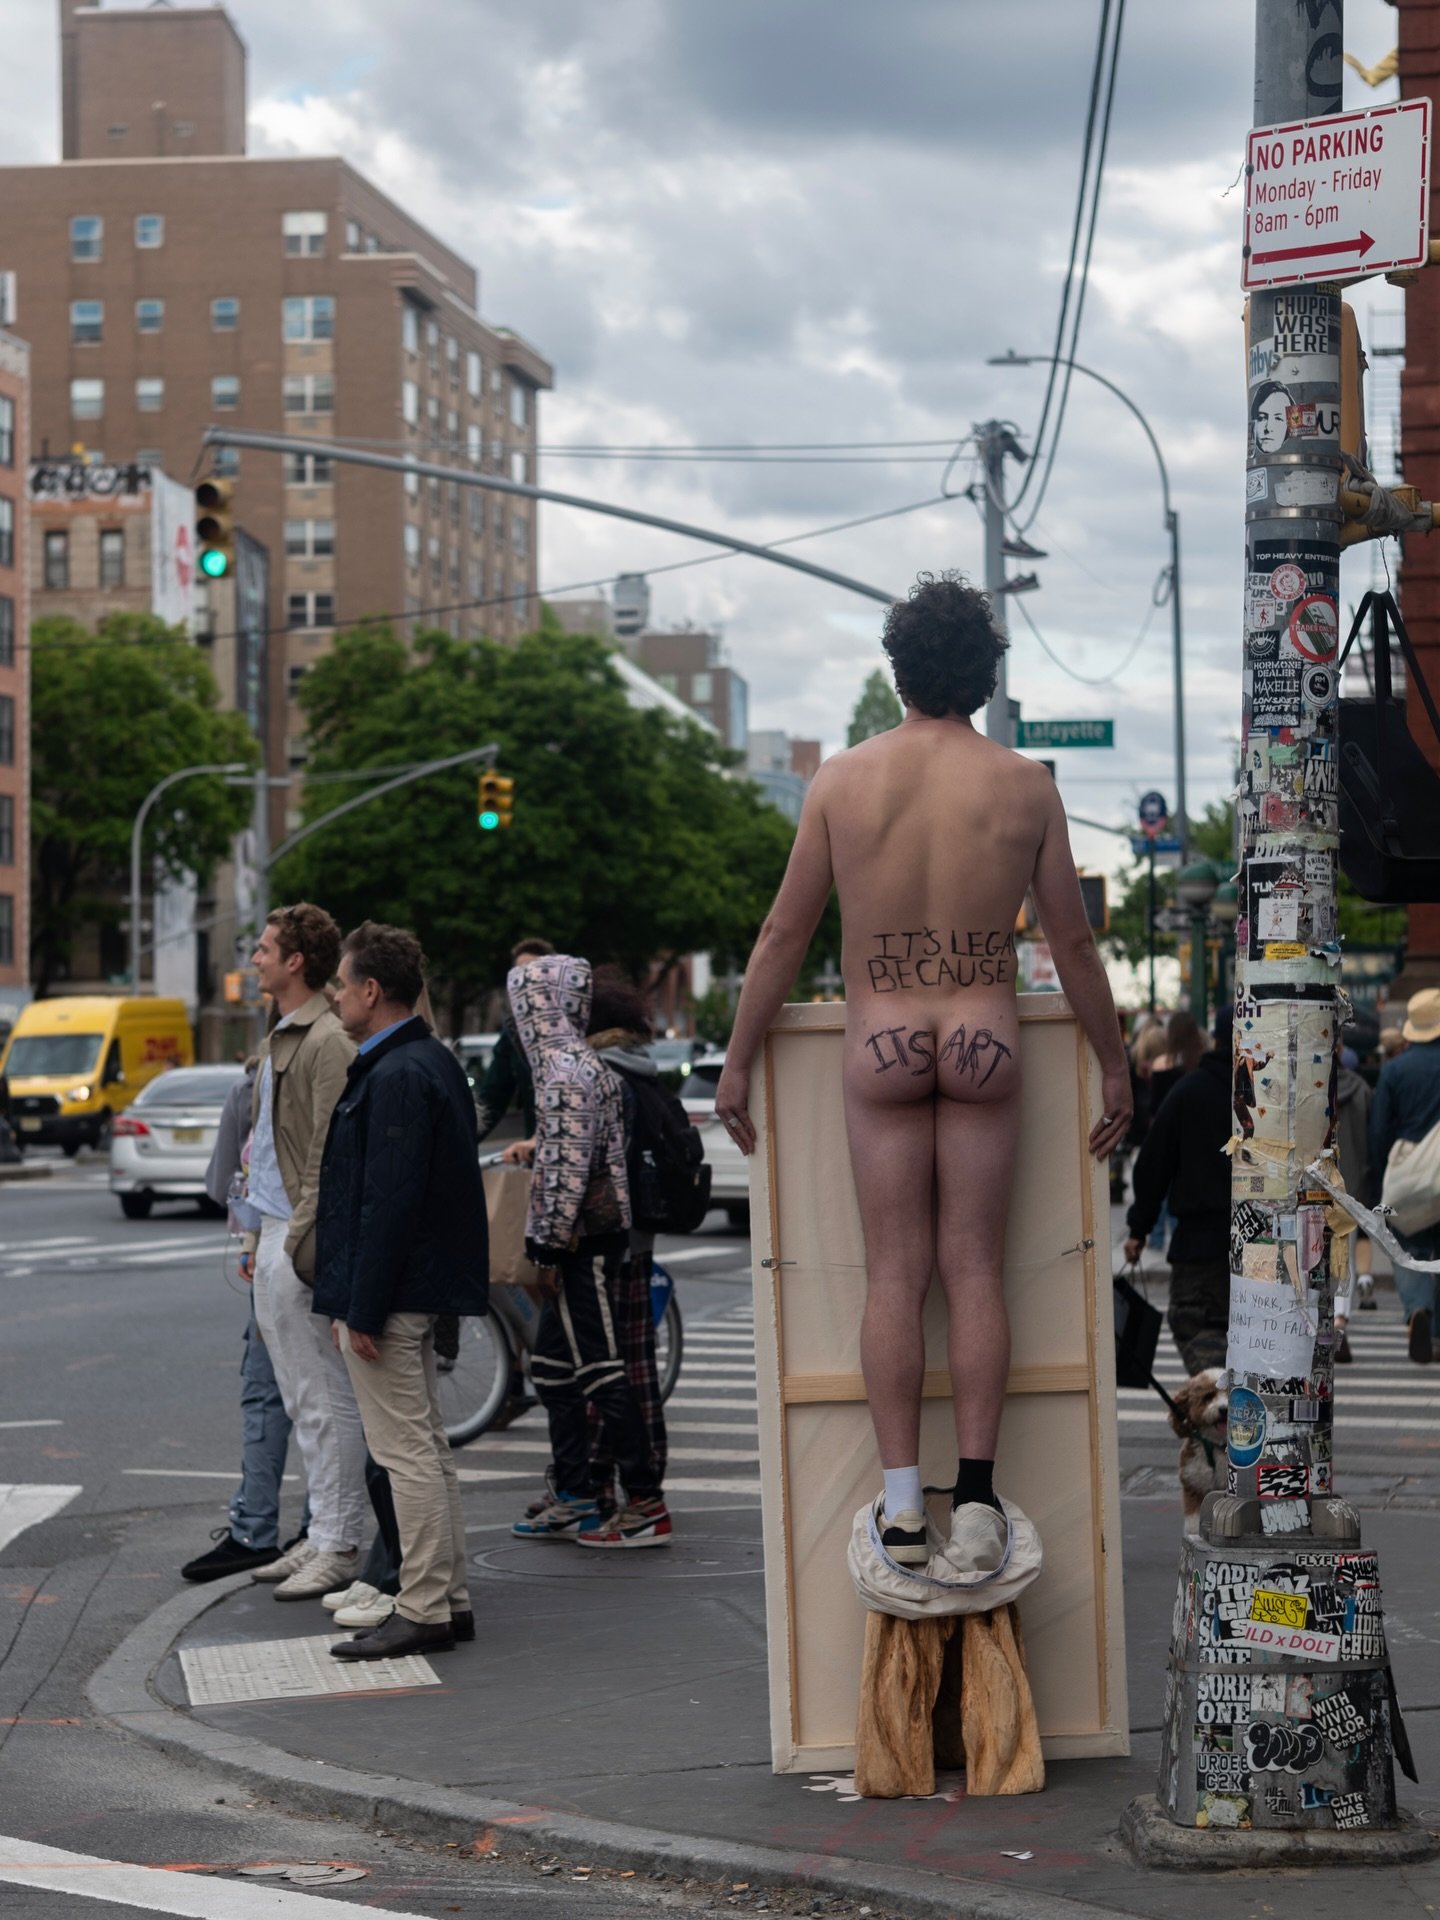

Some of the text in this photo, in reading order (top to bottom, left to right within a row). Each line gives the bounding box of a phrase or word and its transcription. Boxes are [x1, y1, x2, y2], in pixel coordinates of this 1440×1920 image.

[1256, 124, 1384, 172] NO PARKING
[1255, 177, 1316, 205] Monday
[1333, 166, 1382, 192] Friday
[1254, 211, 1288, 234] 8am
[1305, 204, 1339, 230] 6pm
[1274, 296, 1328, 316] CHUPA
[1276, 315, 1326, 334] WAS
[1274, 334, 1328, 353] HERE
[1253, 660, 1302, 670] HORMONE
[1257, 669, 1296, 677] DEALER
[1023, 722, 1105, 743] Lafayette
[873, 926, 942, 960] IT'S
[867, 957, 1009, 993] BECAUSE
[937, 1023, 1012, 1089] ART
[1262, 1319, 1278, 1332] TO
[1289, 1635, 1335, 1655] DOLT
[1197, 1673, 1250, 1701] SORE
[1197, 1701, 1250, 1724] ONE
[1312, 1691, 1350, 1717] WITH
[1316, 1704, 1357, 1731] VIVID
[1322, 1715, 1368, 1741] OLOR
[1205, 1772, 1244, 1792] C2K
[1330, 1791, 1364, 1808] CLTR
[1333, 1803, 1365, 1819] WAS
[1335, 1813, 1371, 1831] HERE
